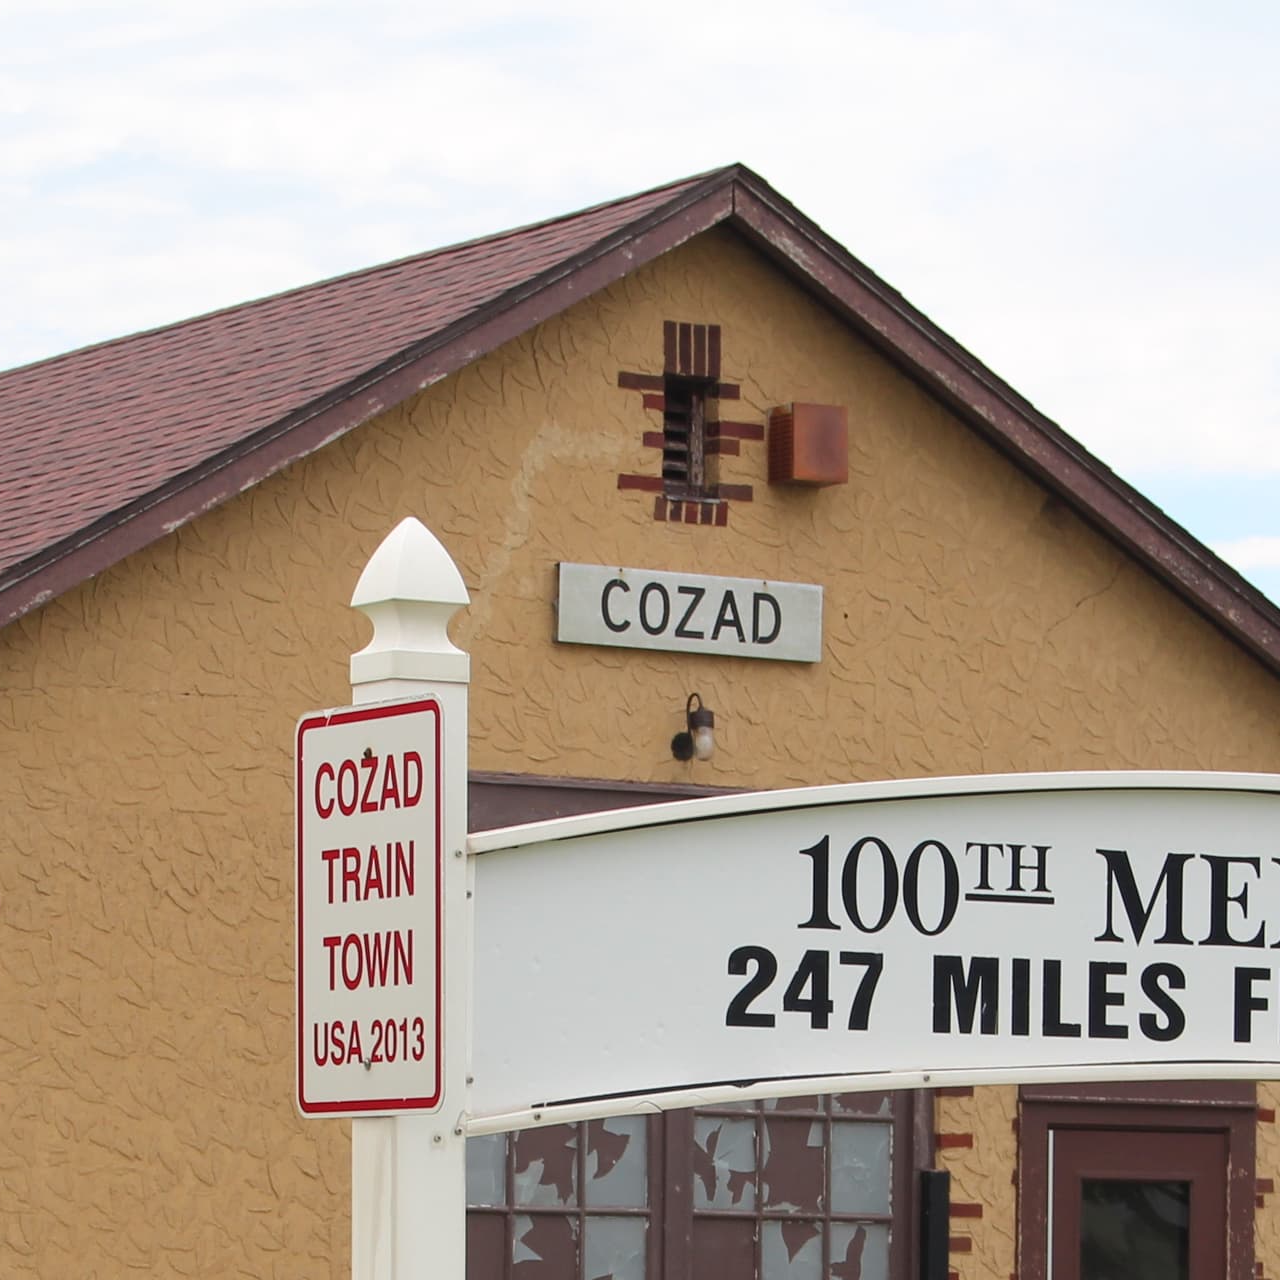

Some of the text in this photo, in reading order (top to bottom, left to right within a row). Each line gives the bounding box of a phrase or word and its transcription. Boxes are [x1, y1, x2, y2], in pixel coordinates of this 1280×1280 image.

[601, 578, 782, 645] COZAD
[314, 751, 424, 819] COZAD
[321, 840, 415, 904] TRAIN
[797, 834, 1054, 936] 100TH
[323, 929, 414, 991] TOWN
[725, 945, 884, 1031] 247
[932, 954, 1187, 1043] MILES
[370, 1016, 425, 1064] 2013
